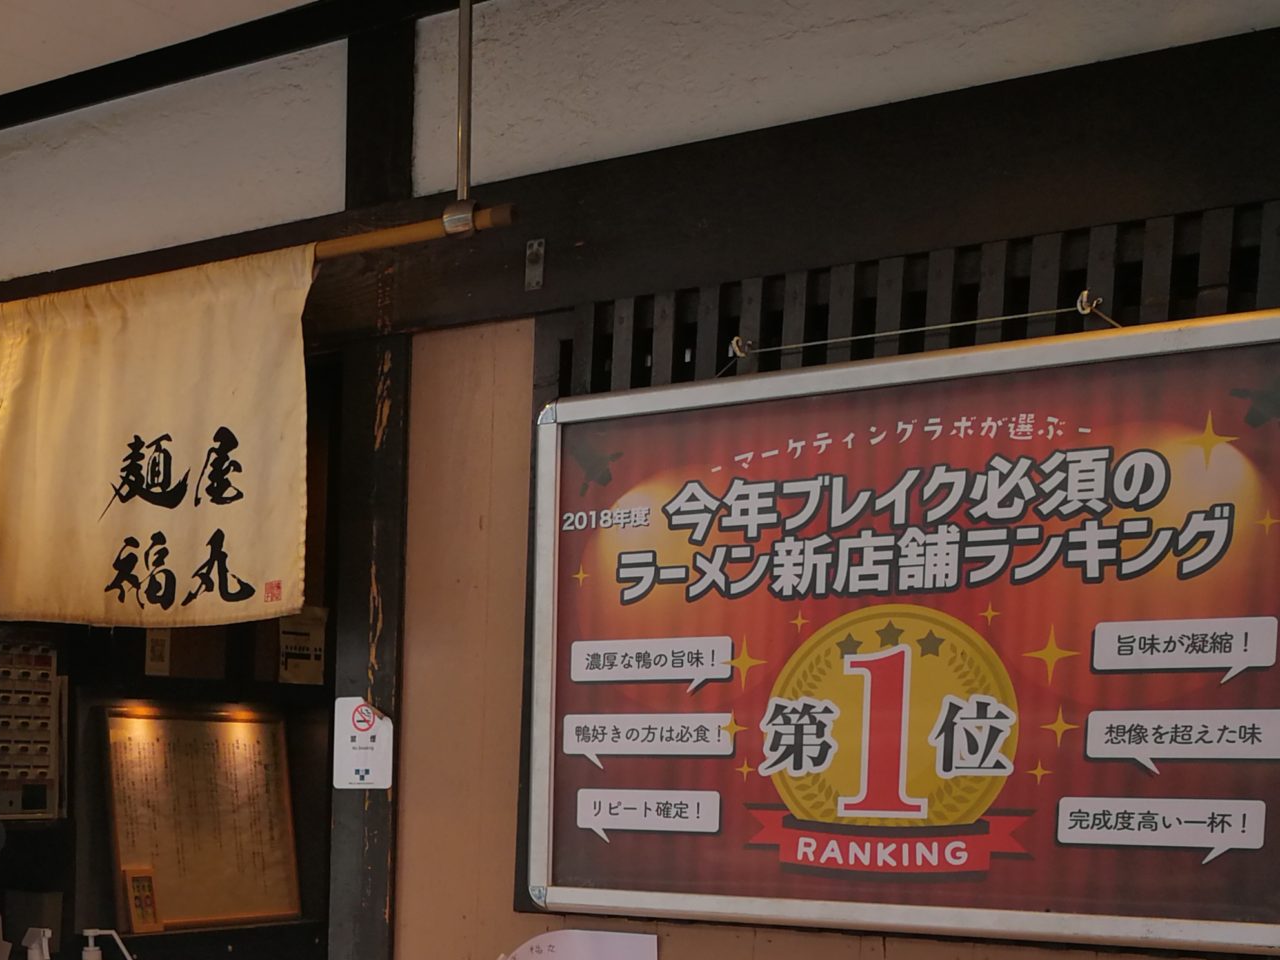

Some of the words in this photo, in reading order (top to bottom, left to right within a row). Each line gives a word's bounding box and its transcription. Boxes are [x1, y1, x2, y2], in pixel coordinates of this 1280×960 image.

[665, 445, 1169, 544] 今年ブレイク必須の
[562, 505, 651, 533] 2018年度
[616, 503, 1233, 602] ラーメン新店舗ランキング
[1115, 630, 1250, 656] 旨味が凝縮！
[584, 649, 716, 671] 濃厚な鴨の旨味！
[574, 722, 723, 745] 鴨好きの方は必食！
[1103, 721, 1263, 747] 想像を超えた味
[592, 799, 703, 820] リピート確定！
[1068, 808, 1249, 835] 完成度高い一杯！
[796, 836, 969, 867] RANKING
